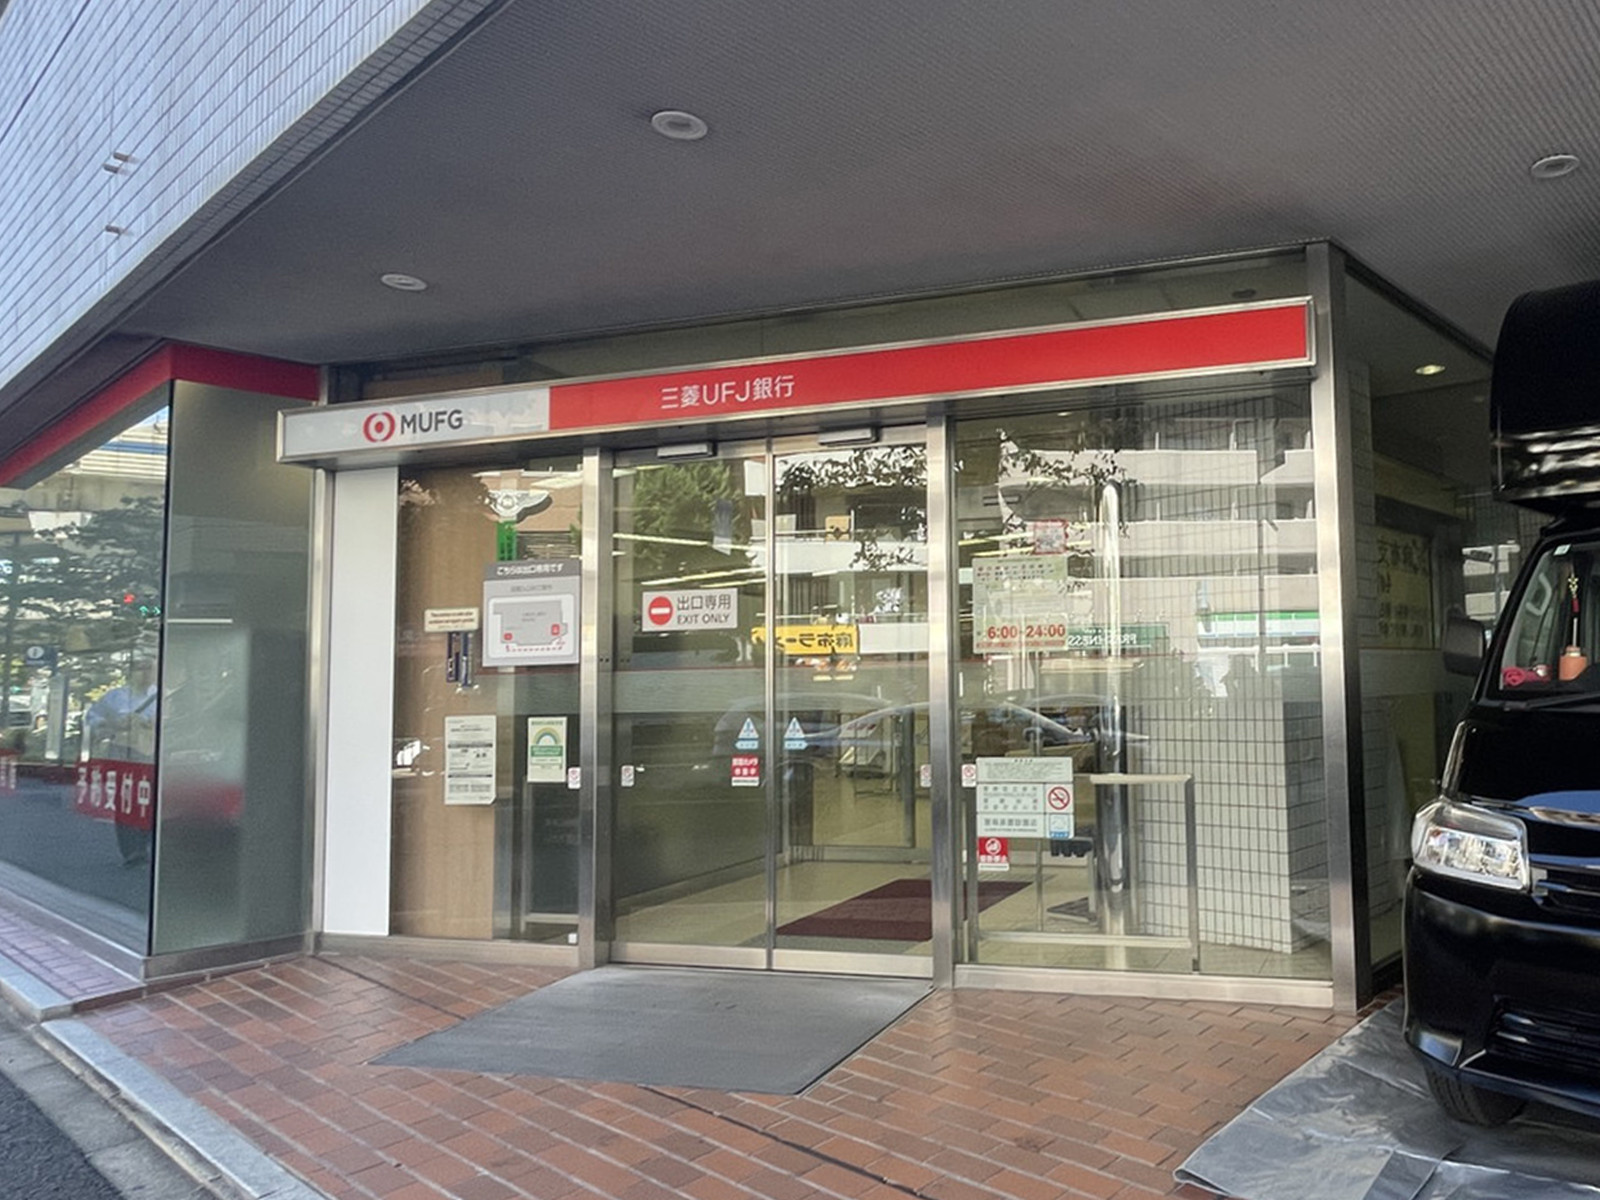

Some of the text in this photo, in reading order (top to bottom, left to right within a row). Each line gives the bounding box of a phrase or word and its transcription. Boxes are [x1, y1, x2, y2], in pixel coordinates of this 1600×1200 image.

[660, 374, 795, 410] 三菱UFJ銀行
[400, 409, 463, 435] MUFG
[677, 593, 731, 610] 出口専用
[677, 612, 730, 625] EXIT ONLY
[76, 765, 151, 818] 予約受付中
